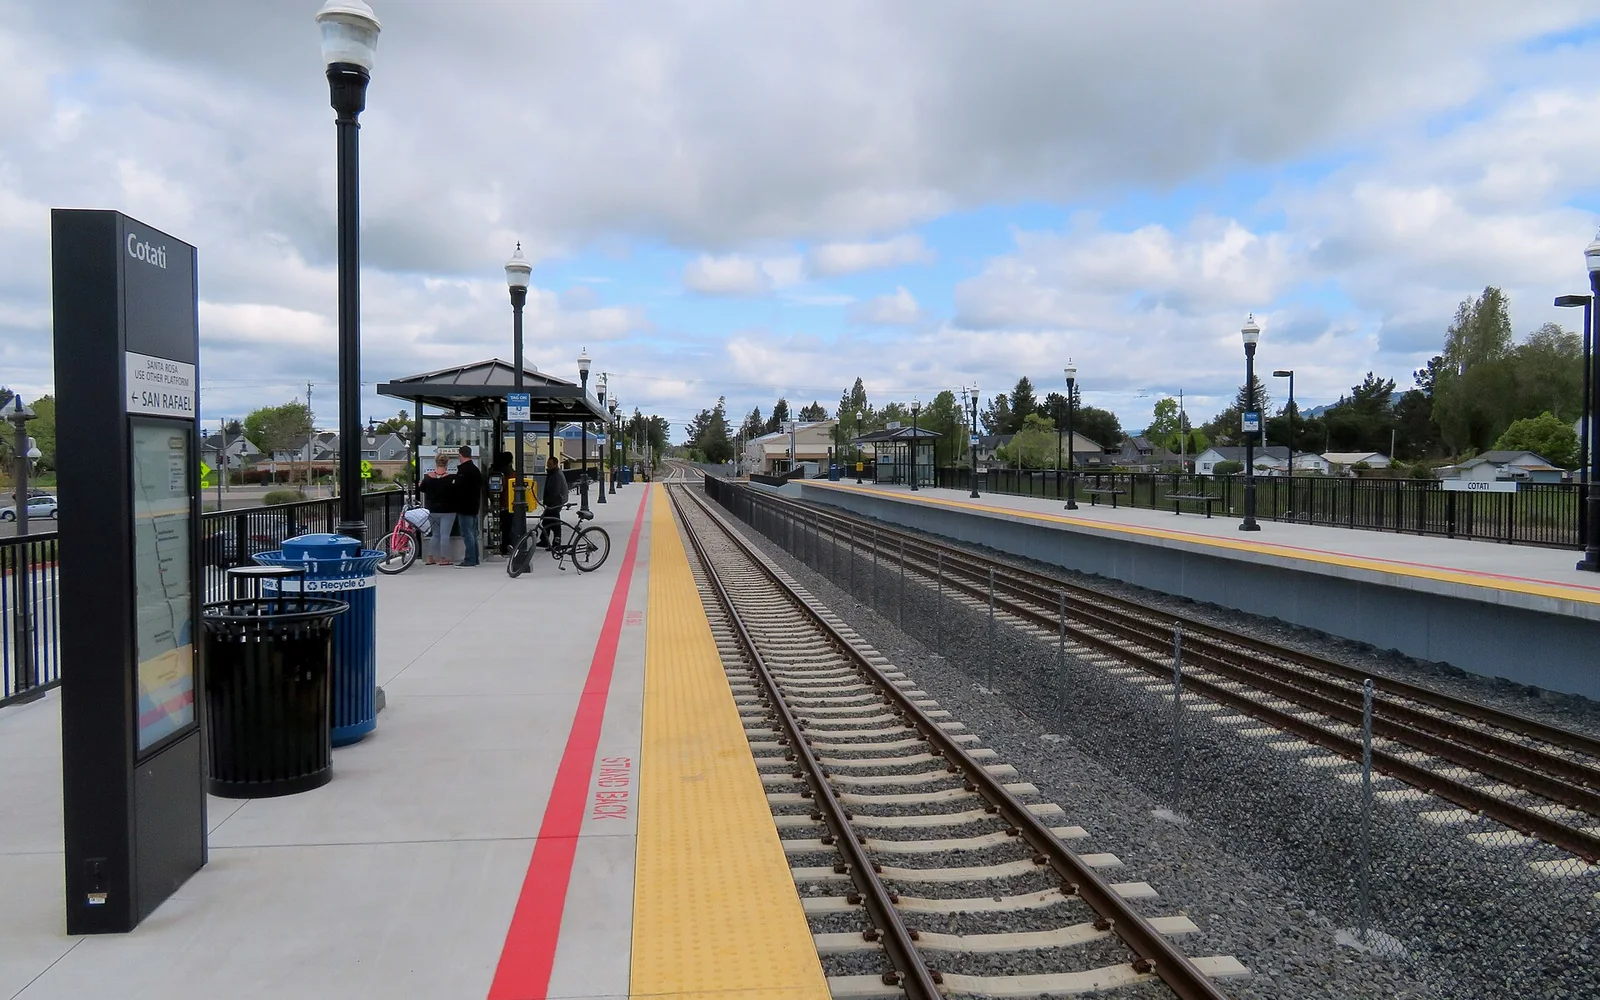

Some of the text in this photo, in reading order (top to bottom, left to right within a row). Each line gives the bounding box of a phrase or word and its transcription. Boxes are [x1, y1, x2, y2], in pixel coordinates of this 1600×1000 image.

[127, 233, 166, 269] Cotati
[147, 360, 178, 374] SANTA ROSA
[135, 370, 189, 387] USE OTHER PLATFORM
[142, 391, 192, 411] SAN RAFAEL
[1467, 482, 1490, 490] COTATI
[320, 580, 356, 590] Recycle
[592, 757, 630, 820] STAND BACK
